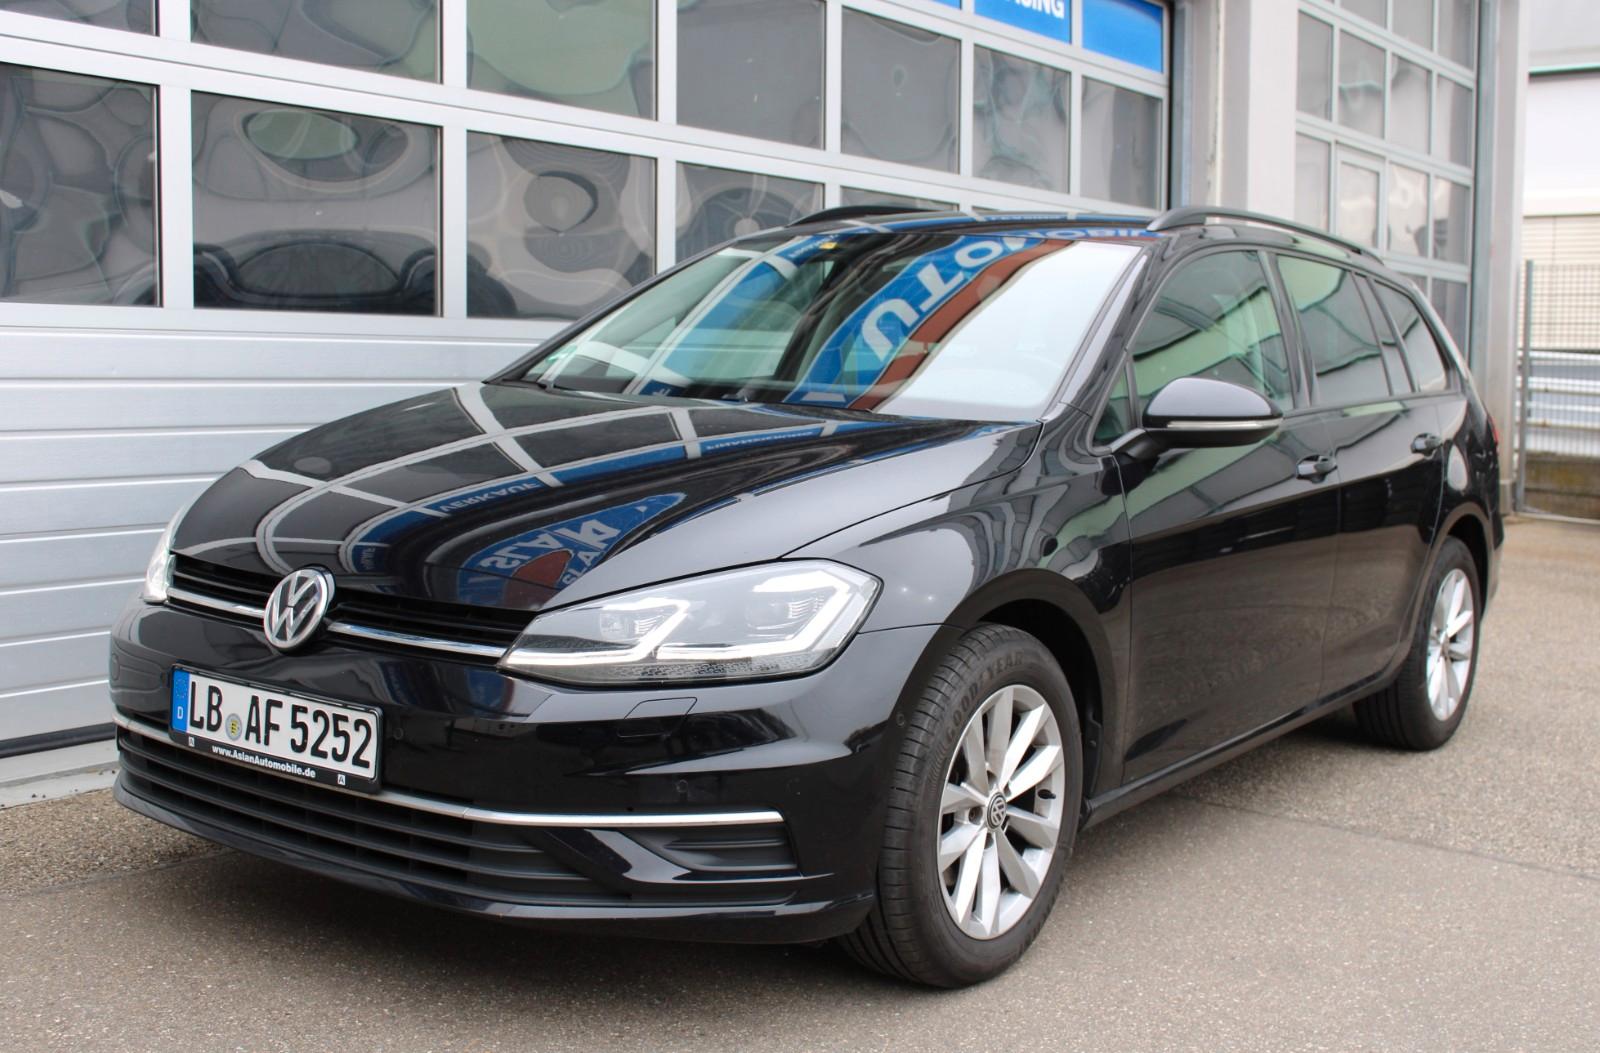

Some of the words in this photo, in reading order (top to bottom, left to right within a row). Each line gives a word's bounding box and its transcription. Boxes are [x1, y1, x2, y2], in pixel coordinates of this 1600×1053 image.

[177, 706, 184, 719] D
[189, 681, 223, 732] LB
[245, 695, 284, 746] AF
[290, 704, 372, 769] 5252
[212, 744, 316, 778] www.AsianAutomobile.de
